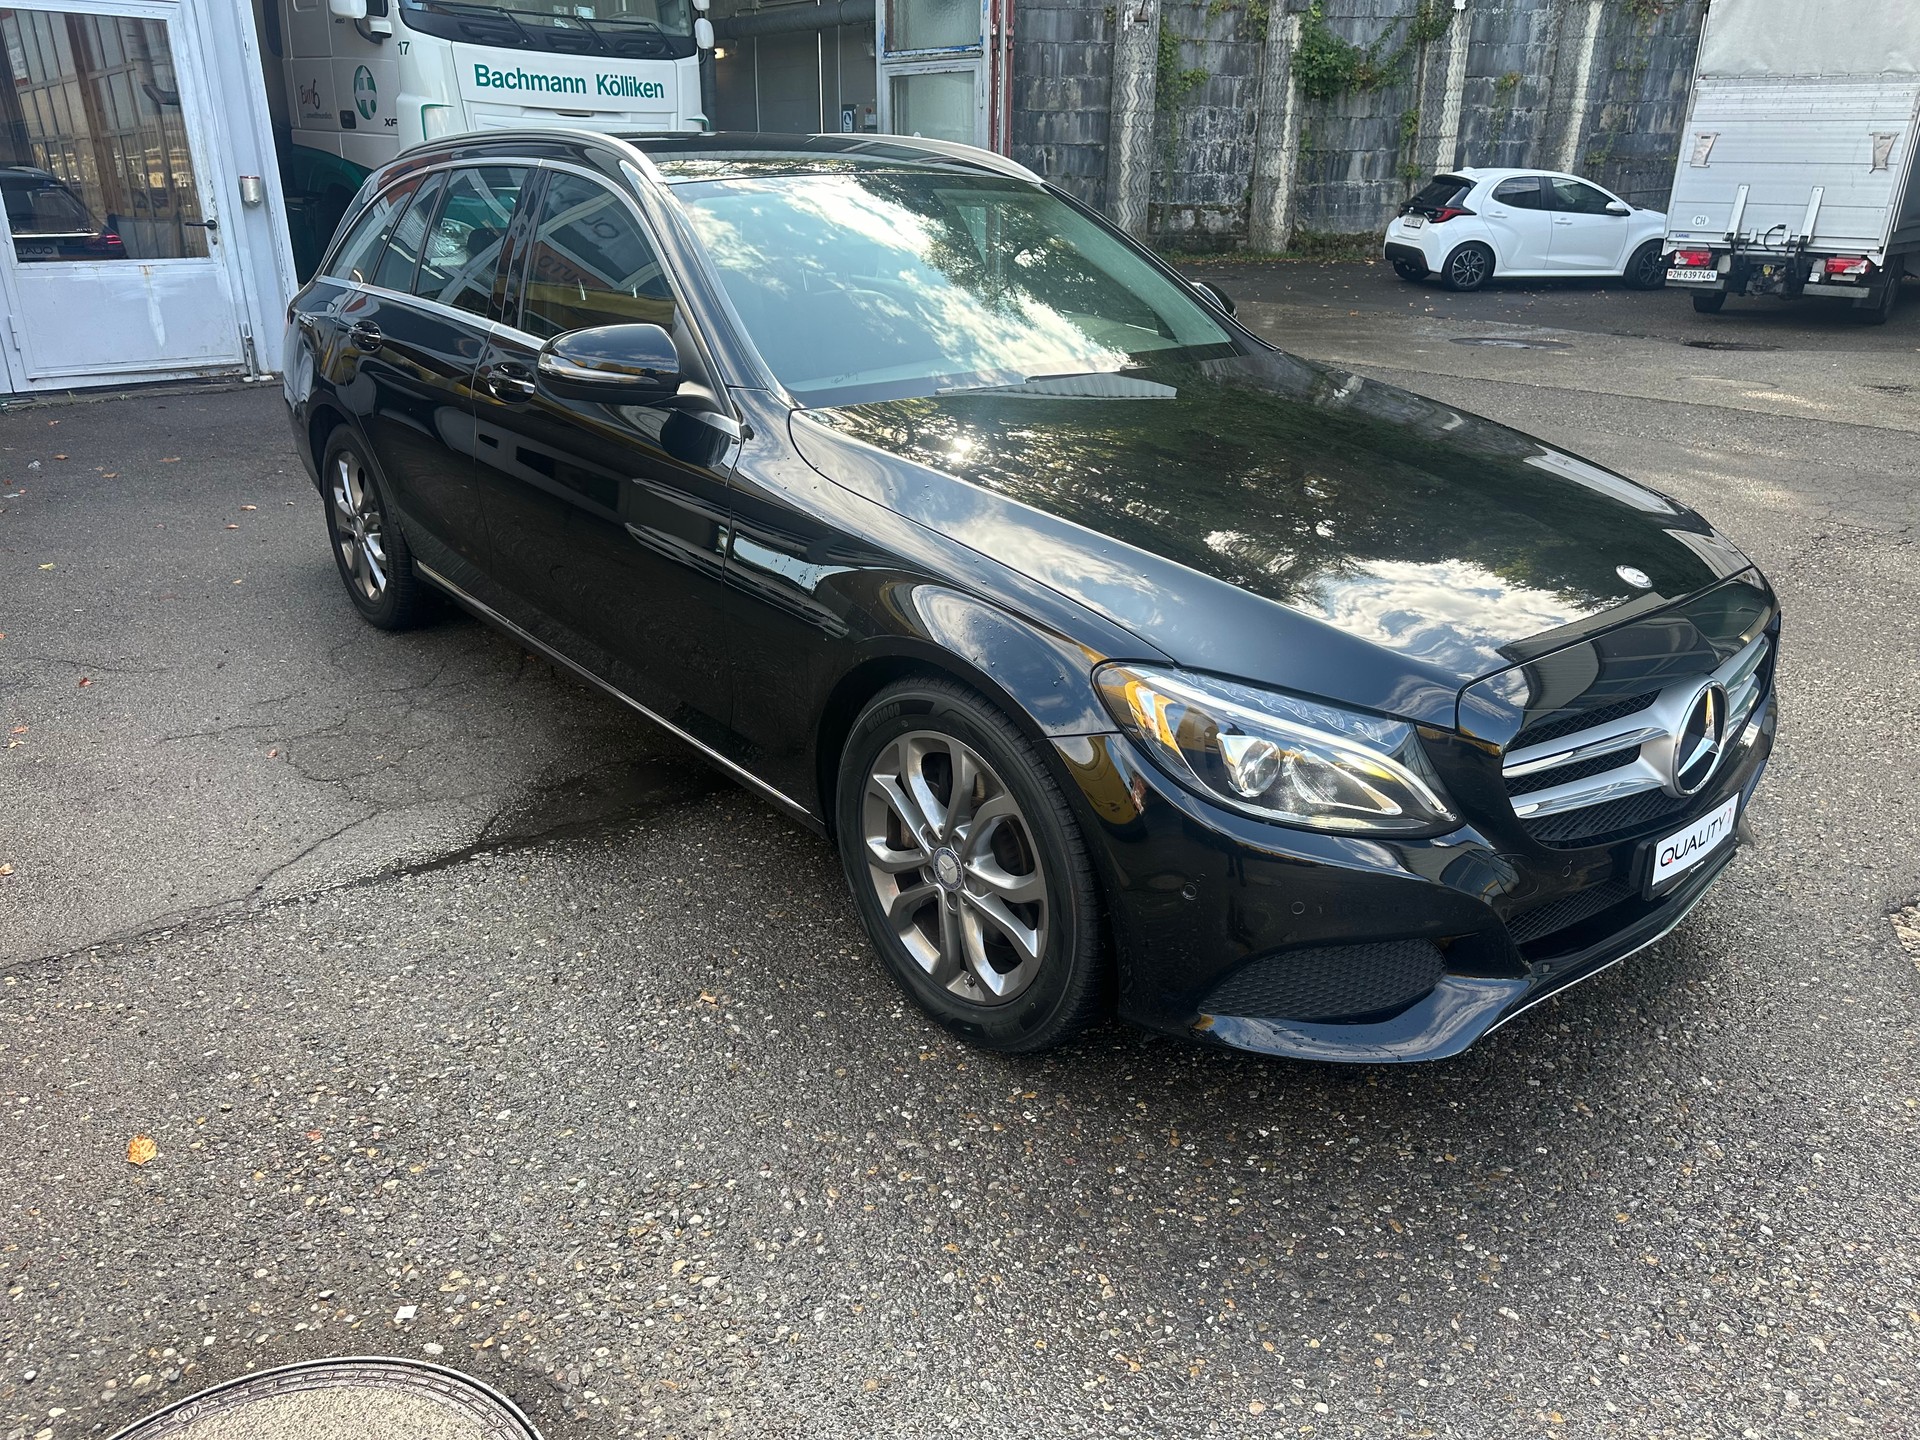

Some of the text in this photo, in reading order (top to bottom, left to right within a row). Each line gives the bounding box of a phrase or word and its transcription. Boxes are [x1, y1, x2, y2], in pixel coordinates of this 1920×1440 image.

[397, 41, 410, 56] 17
[474, 63, 665, 99] Bachmann Kölliken
[384, 118, 398, 127] XF
[1695, 216, 1706, 225] CH
